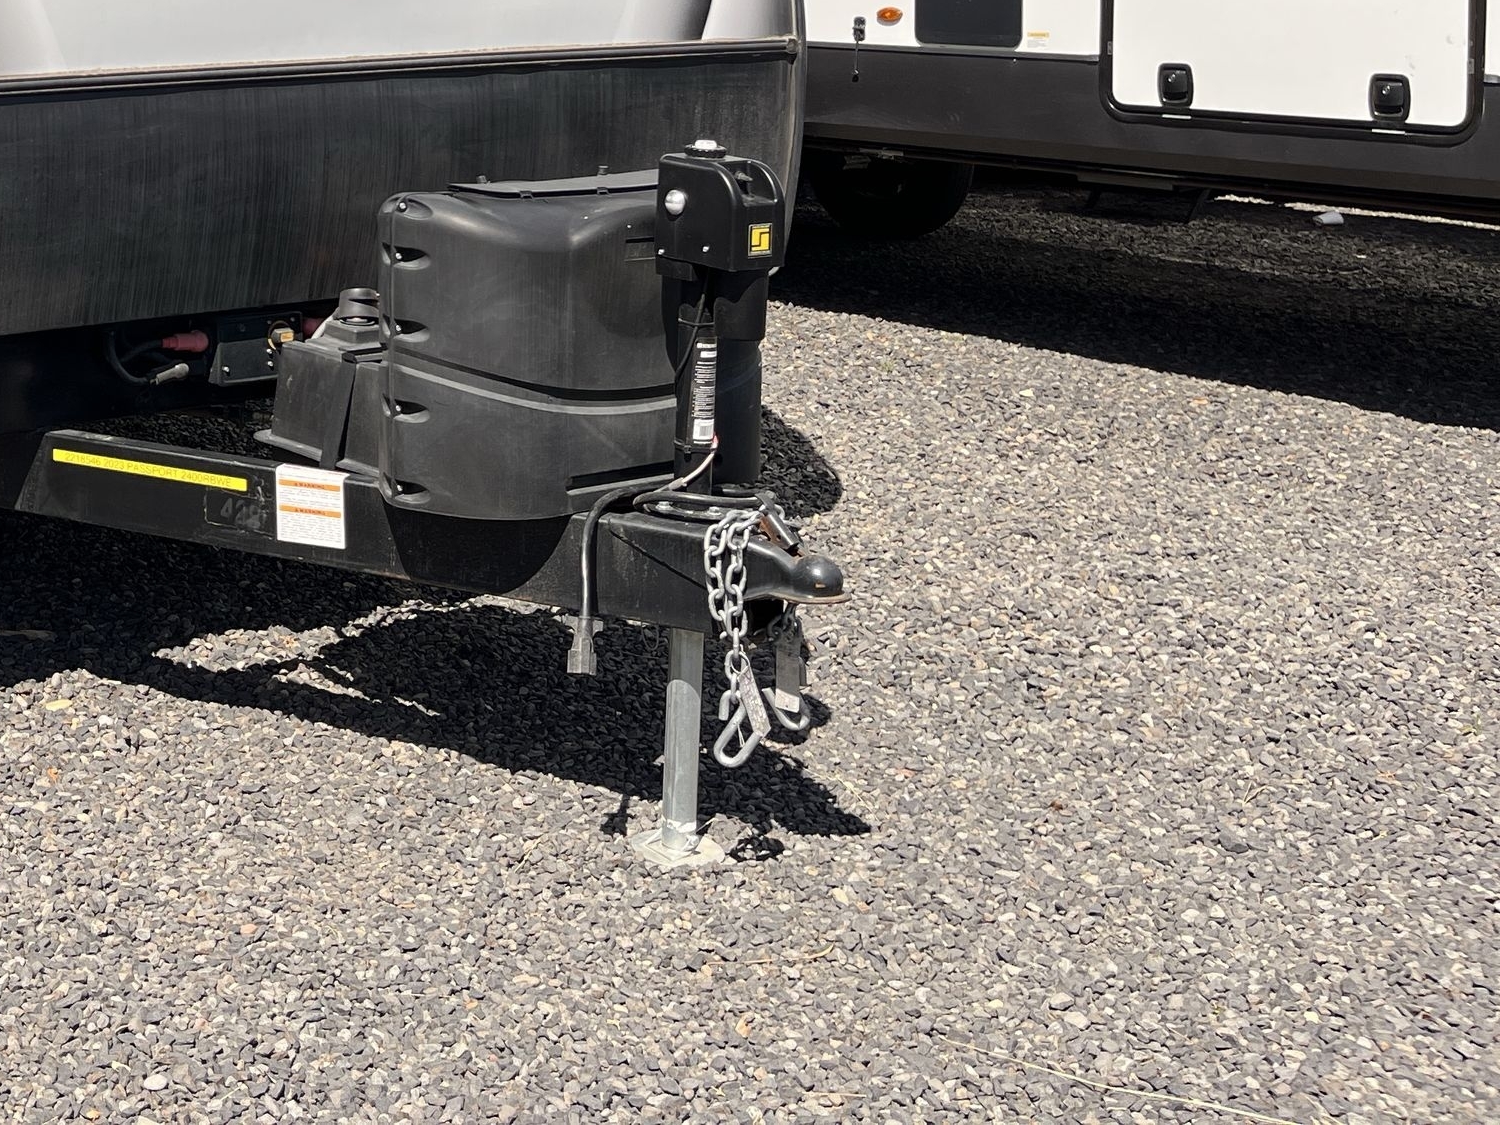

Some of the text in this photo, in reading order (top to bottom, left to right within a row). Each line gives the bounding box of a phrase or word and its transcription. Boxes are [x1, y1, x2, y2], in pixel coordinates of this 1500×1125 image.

[64, 452, 232, 488] 2218546 2023 PASSPORT 2400RBWE
